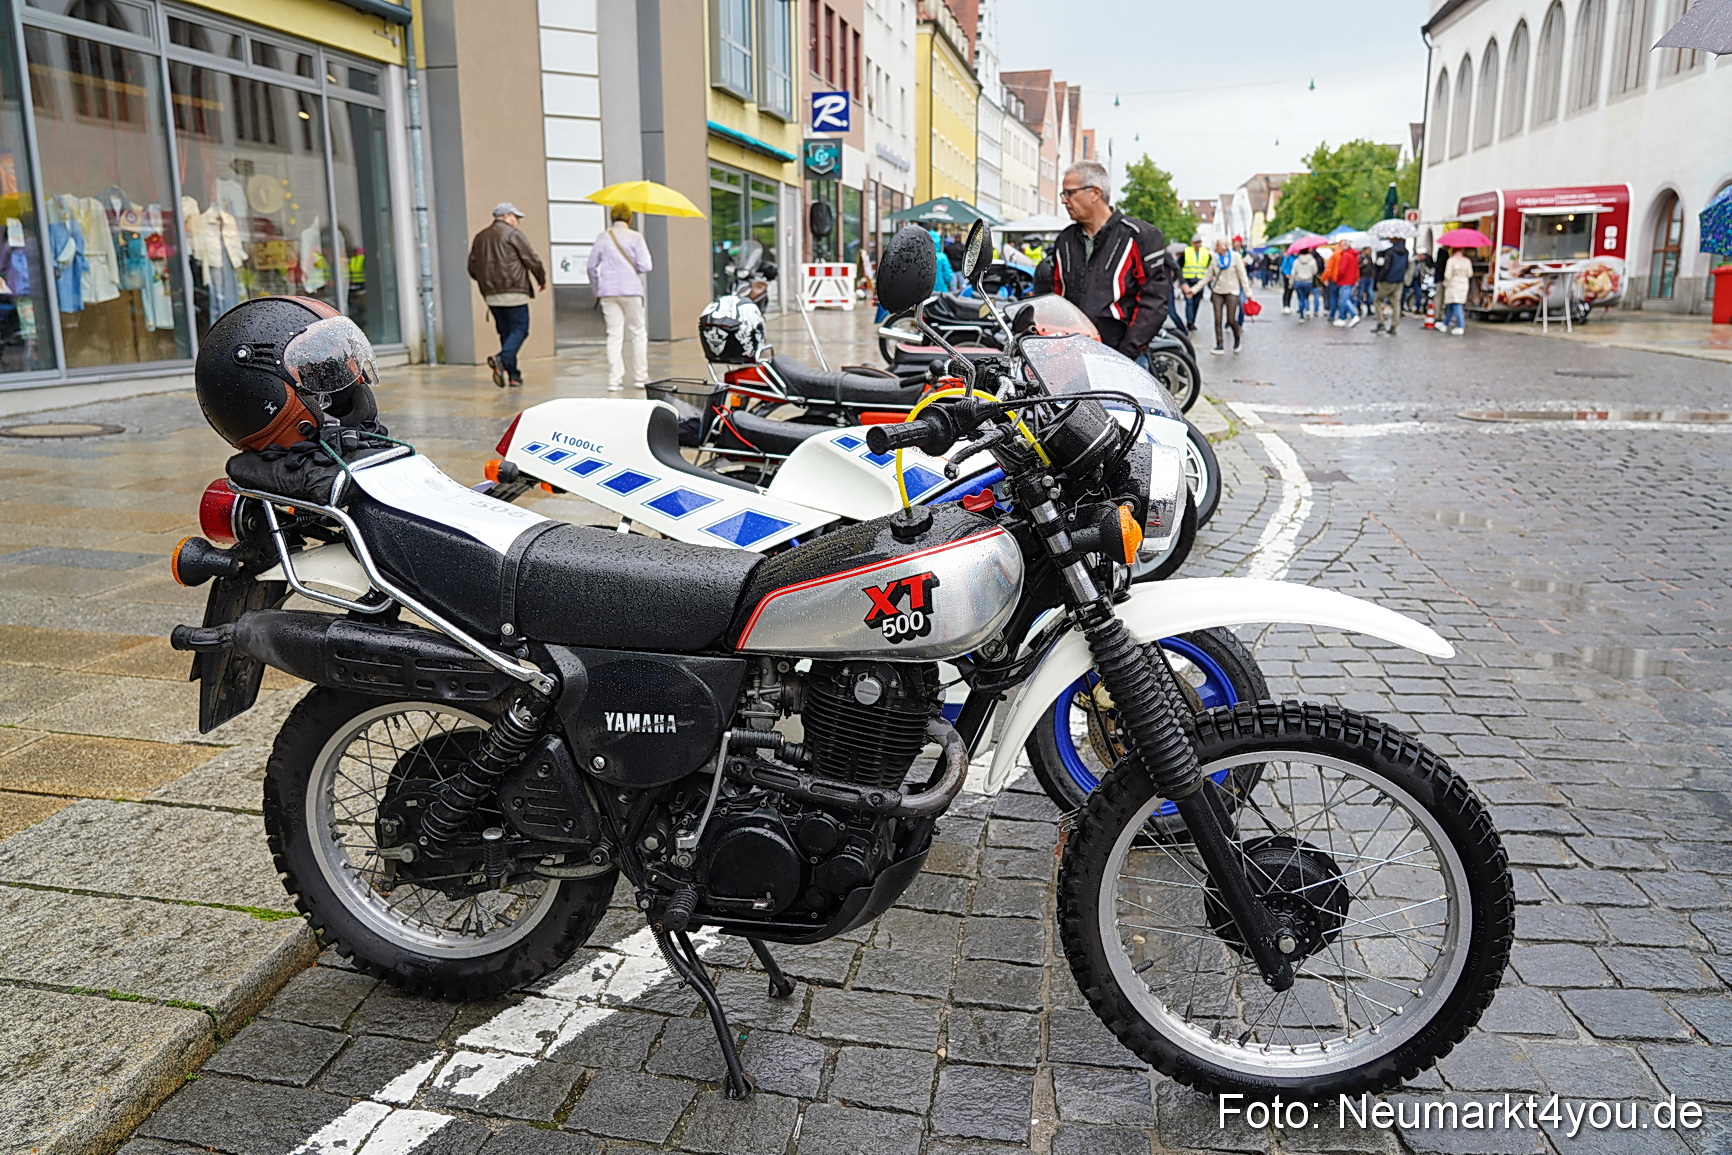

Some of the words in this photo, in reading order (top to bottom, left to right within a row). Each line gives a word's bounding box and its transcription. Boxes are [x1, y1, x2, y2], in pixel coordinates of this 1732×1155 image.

[863, 571, 935, 623] XT
[882, 611, 924, 638] 500
[604, 711, 677, 734] YAMAHA
